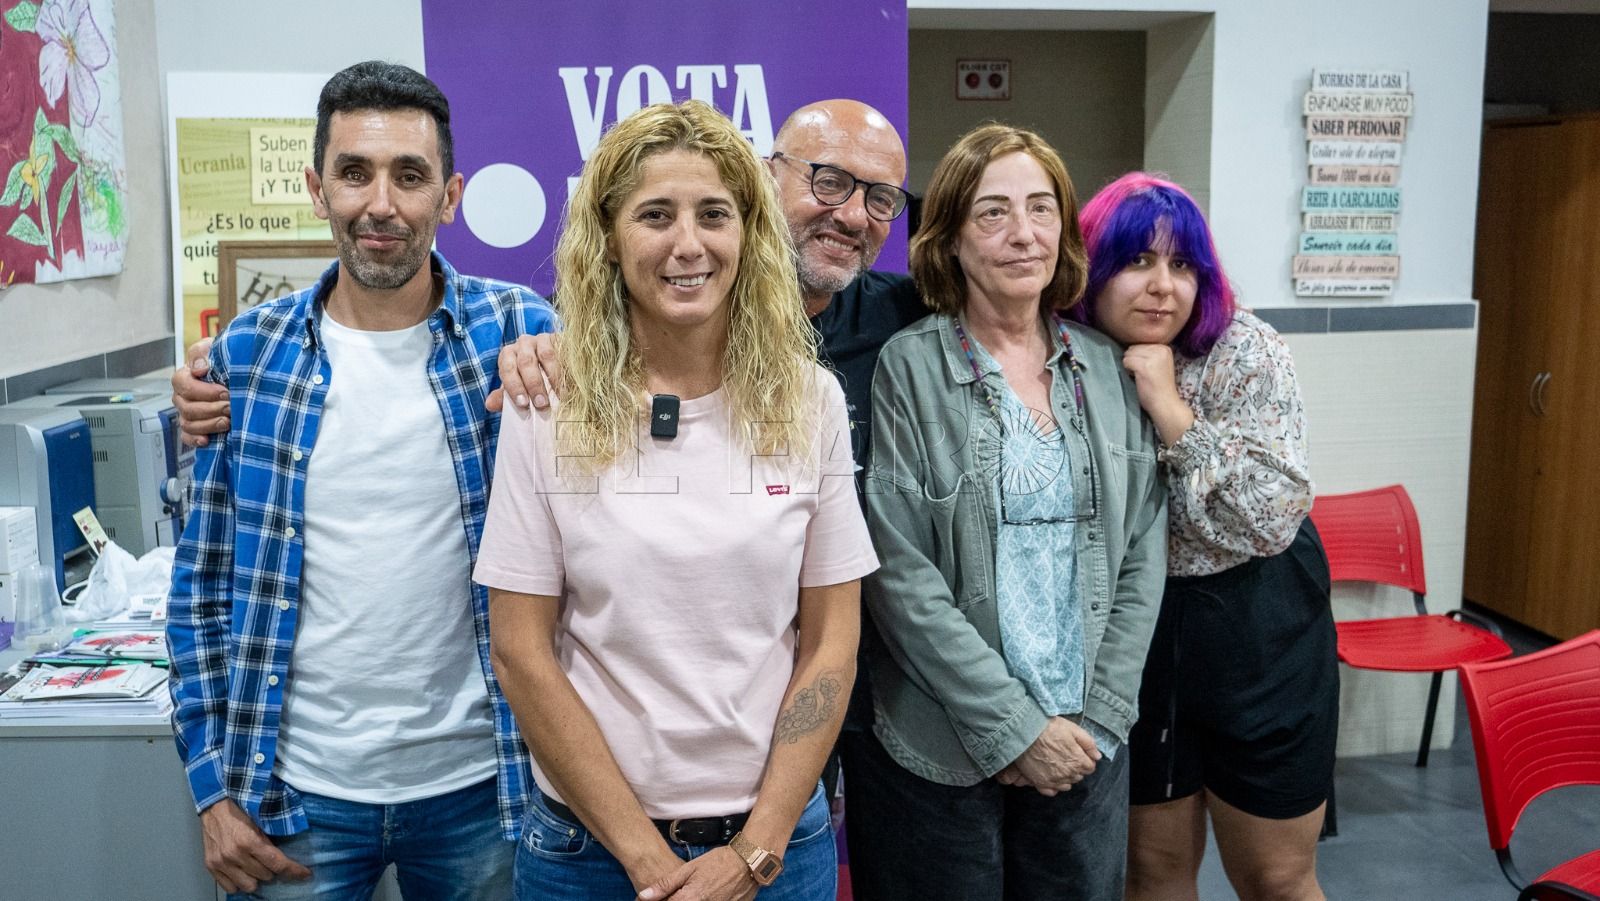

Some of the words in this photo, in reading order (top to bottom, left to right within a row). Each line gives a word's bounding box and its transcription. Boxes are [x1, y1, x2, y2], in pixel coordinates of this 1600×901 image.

[1320, 73, 1354, 88] NORMAS
[1355, 74, 1367, 88] DE
[1369, 74, 1379, 88] LA
[1381, 74, 1402, 88] CASA
[1308, 96, 1361, 112] ENFADARSE
[1363, 97, 1383, 111] MUY
[1385, 97, 1409, 112] POCO
[1312, 120, 1344, 135] SABER
[1347, 121, 1401, 136] PERDONAR
[259, 135, 307, 151] Suben
[180, 153, 246, 175] Ucrania
[260, 157, 273, 173] la
[278, 157, 303, 173] Luz
[261, 179, 276, 197] ¡Y
[282, 178, 300, 193] Tú
[1331, 192, 1338, 207] A
[1339, 192, 1399, 208] CARCAJADAS
[206, 213, 234, 234] ¿Es
[239, 213, 254, 230] lo
[260, 216, 291, 232] que
[1346, 240, 1371, 251] cada
